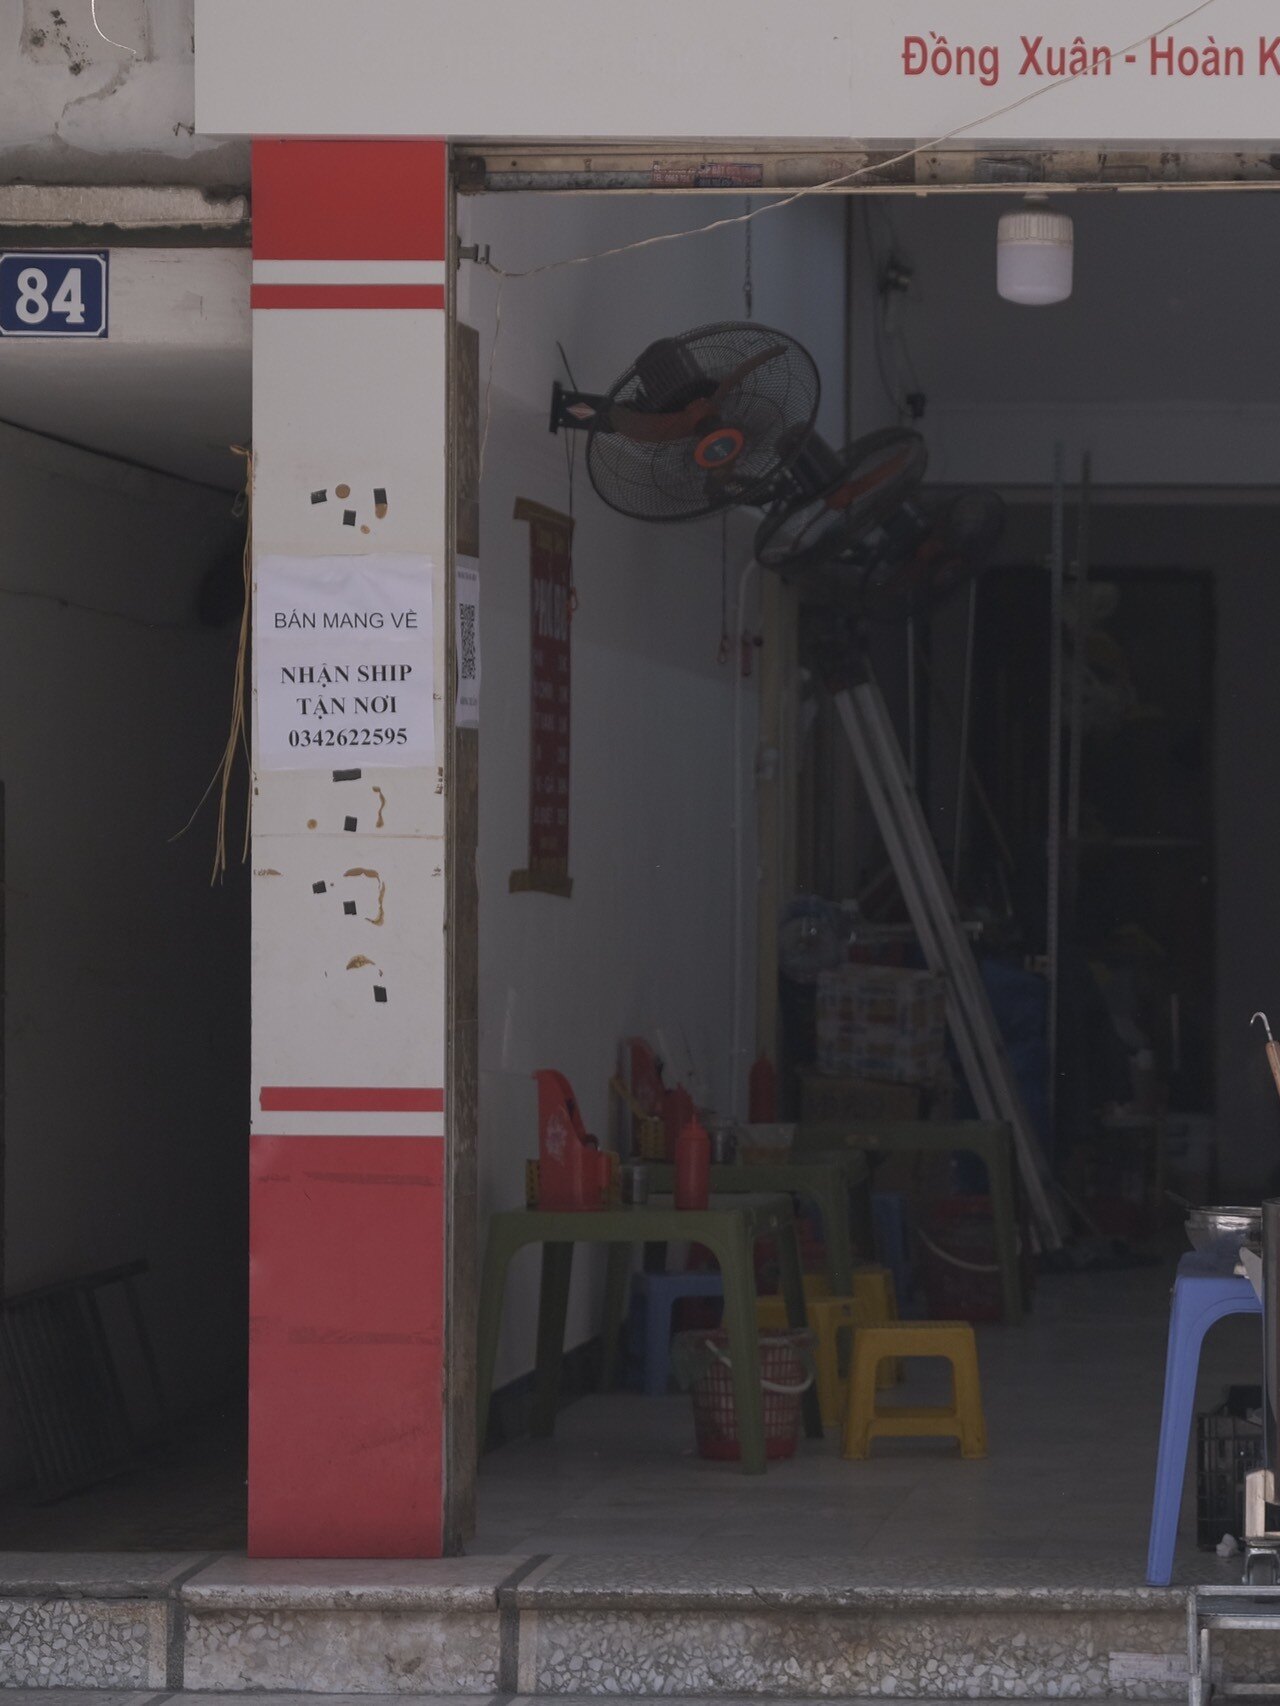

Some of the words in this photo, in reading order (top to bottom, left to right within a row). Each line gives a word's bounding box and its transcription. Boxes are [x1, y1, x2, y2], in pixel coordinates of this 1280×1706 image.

[901, 31, 999, 87] Đồng
[1018, 35, 1112, 76] Xuân
[1124, 53, 1137, 64] -
[1149, 35, 1245, 76] Hoàn
[15, 267, 85, 323] 84
[274, 608, 316, 629] BÁN
[323, 612, 384, 629] MANG
[390, 608, 418, 629] VỀ
[280, 662, 350, 689] NHẬN
[357, 664, 412, 683] SHIP
[296, 694, 346, 720] TẬN
[354, 694, 397, 715] NƠI
[288, 727, 408, 748] 0342622595
